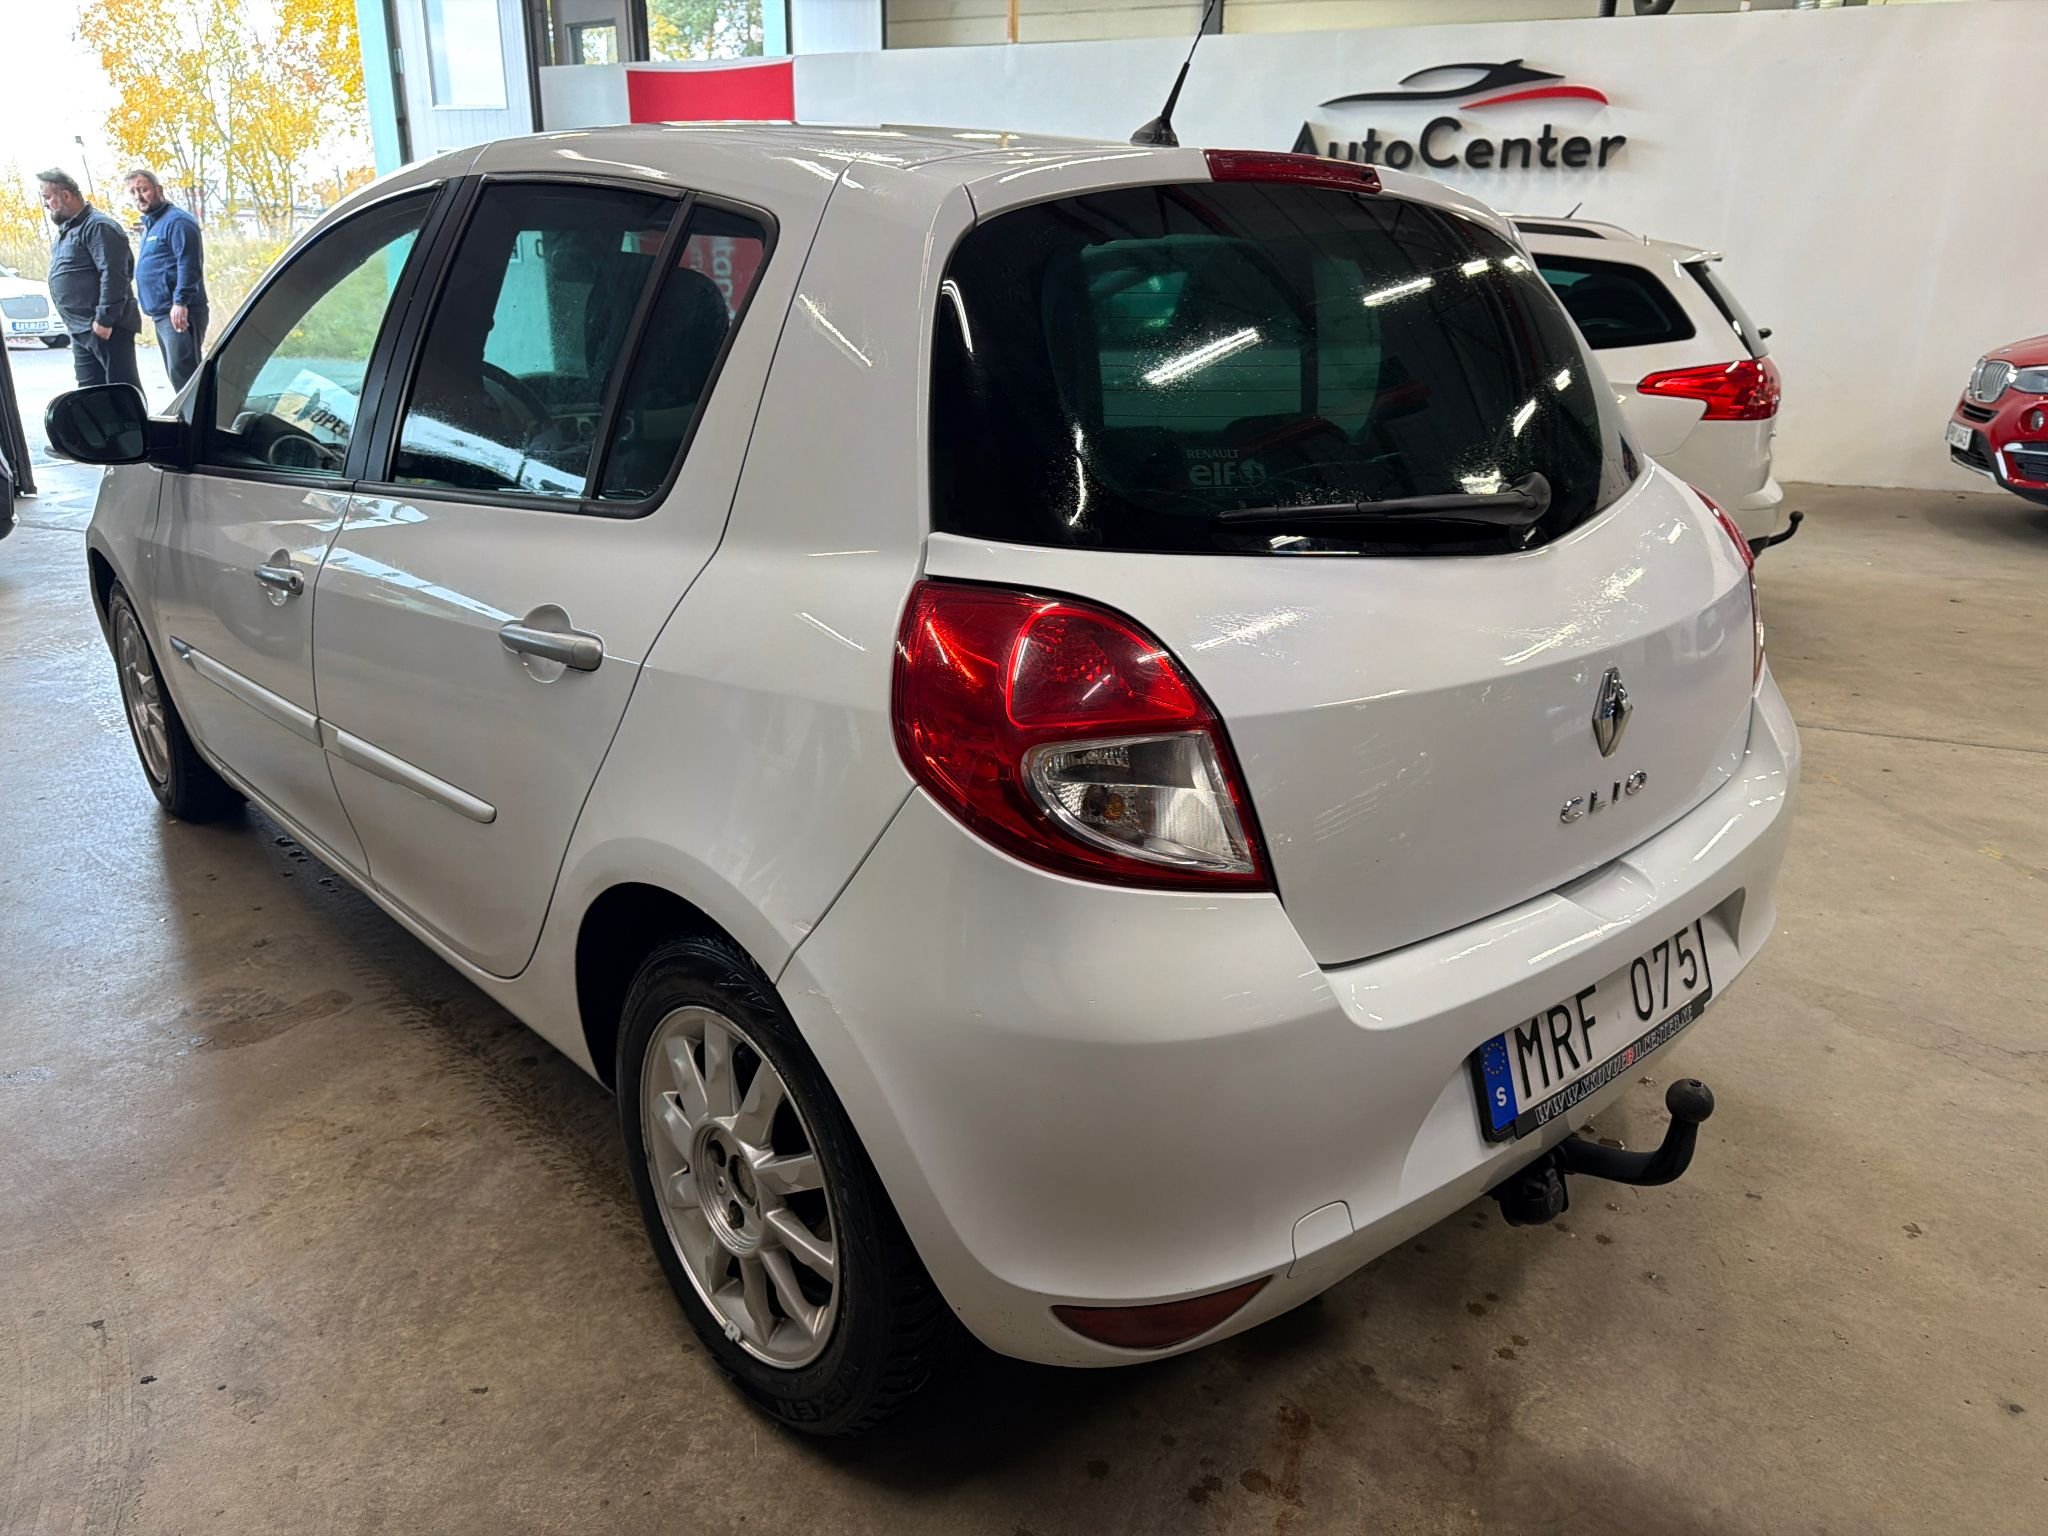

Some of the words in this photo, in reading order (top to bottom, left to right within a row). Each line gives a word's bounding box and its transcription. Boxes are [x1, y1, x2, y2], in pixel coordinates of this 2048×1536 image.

[1290, 116, 1627, 169] AutoCenter
[1186, 448, 1240, 459] RENAULT
[1189, 461, 1237, 486] elf
[1560, 770, 1647, 824] CLIO
[1513, 984, 1597, 1100] MRF
[1630, 927, 1698, 1021] 075
[1495, 1086, 1507, 1107] S
